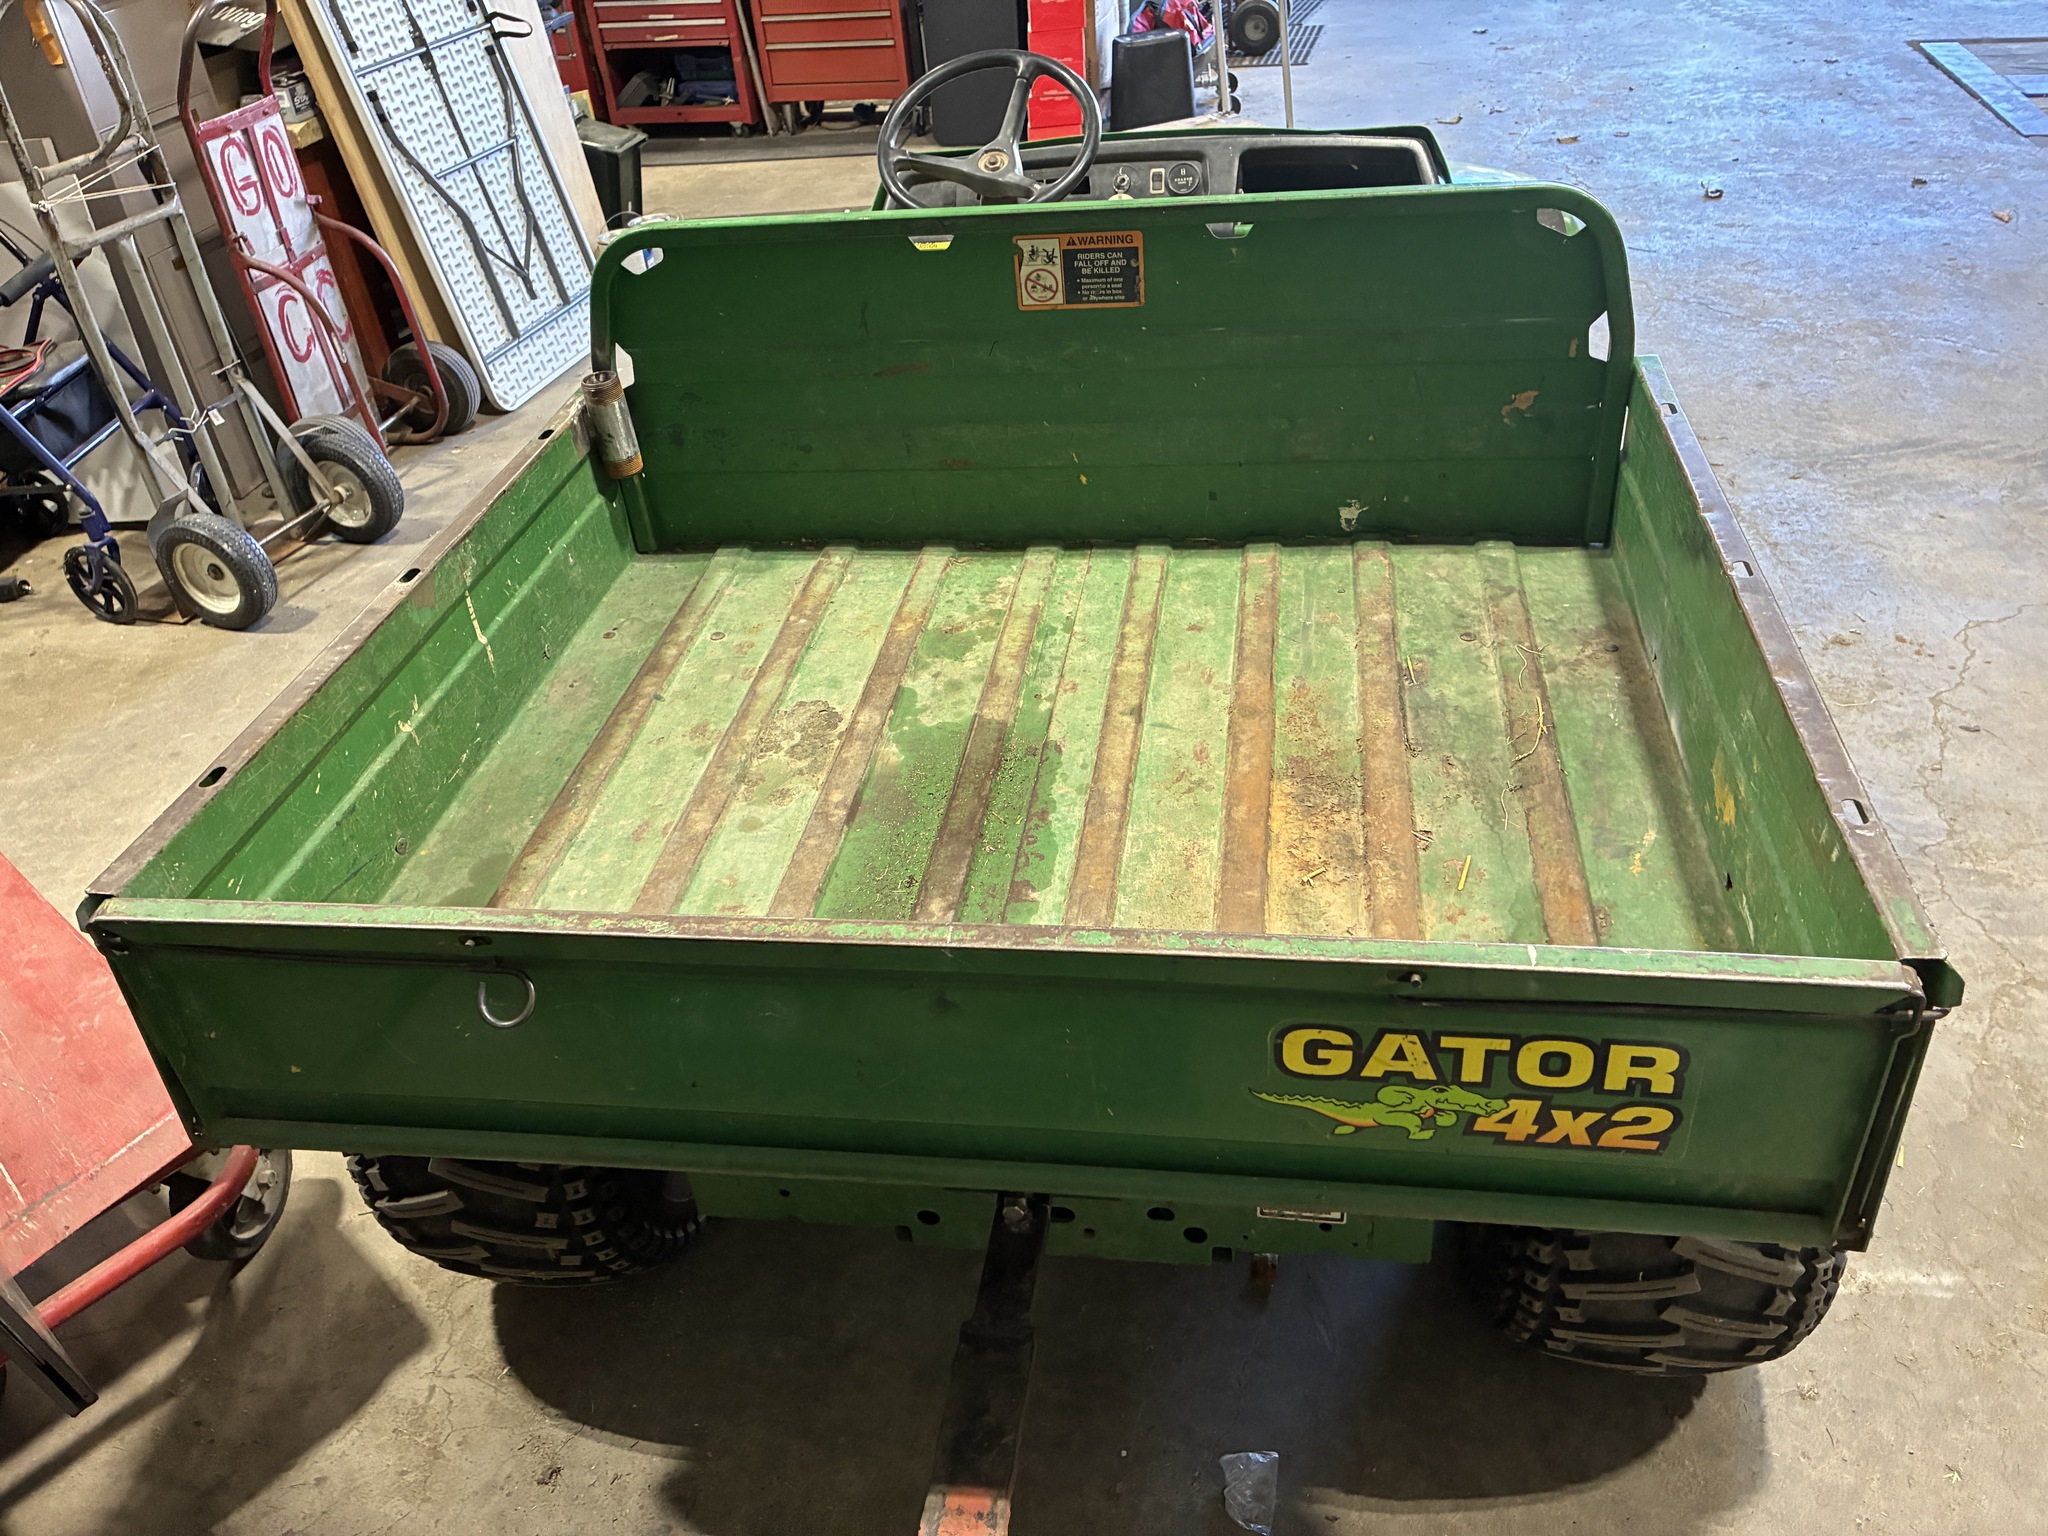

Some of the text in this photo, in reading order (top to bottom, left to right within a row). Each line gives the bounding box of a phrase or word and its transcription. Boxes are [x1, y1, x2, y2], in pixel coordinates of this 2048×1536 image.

[211, 5, 267, 28] Wing
[1077, 234, 1134, 246] WARNING
[1077, 251, 1123, 260] RIDERS CAN
[1074, 260, 1092, 268] FALL
[1093, 259, 1109, 267] OFF
[1081, 267, 1092, 275] BE
[1280, 1027, 1681, 1095] GATOR
[1471, 1097, 1675, 1151] 4x2
